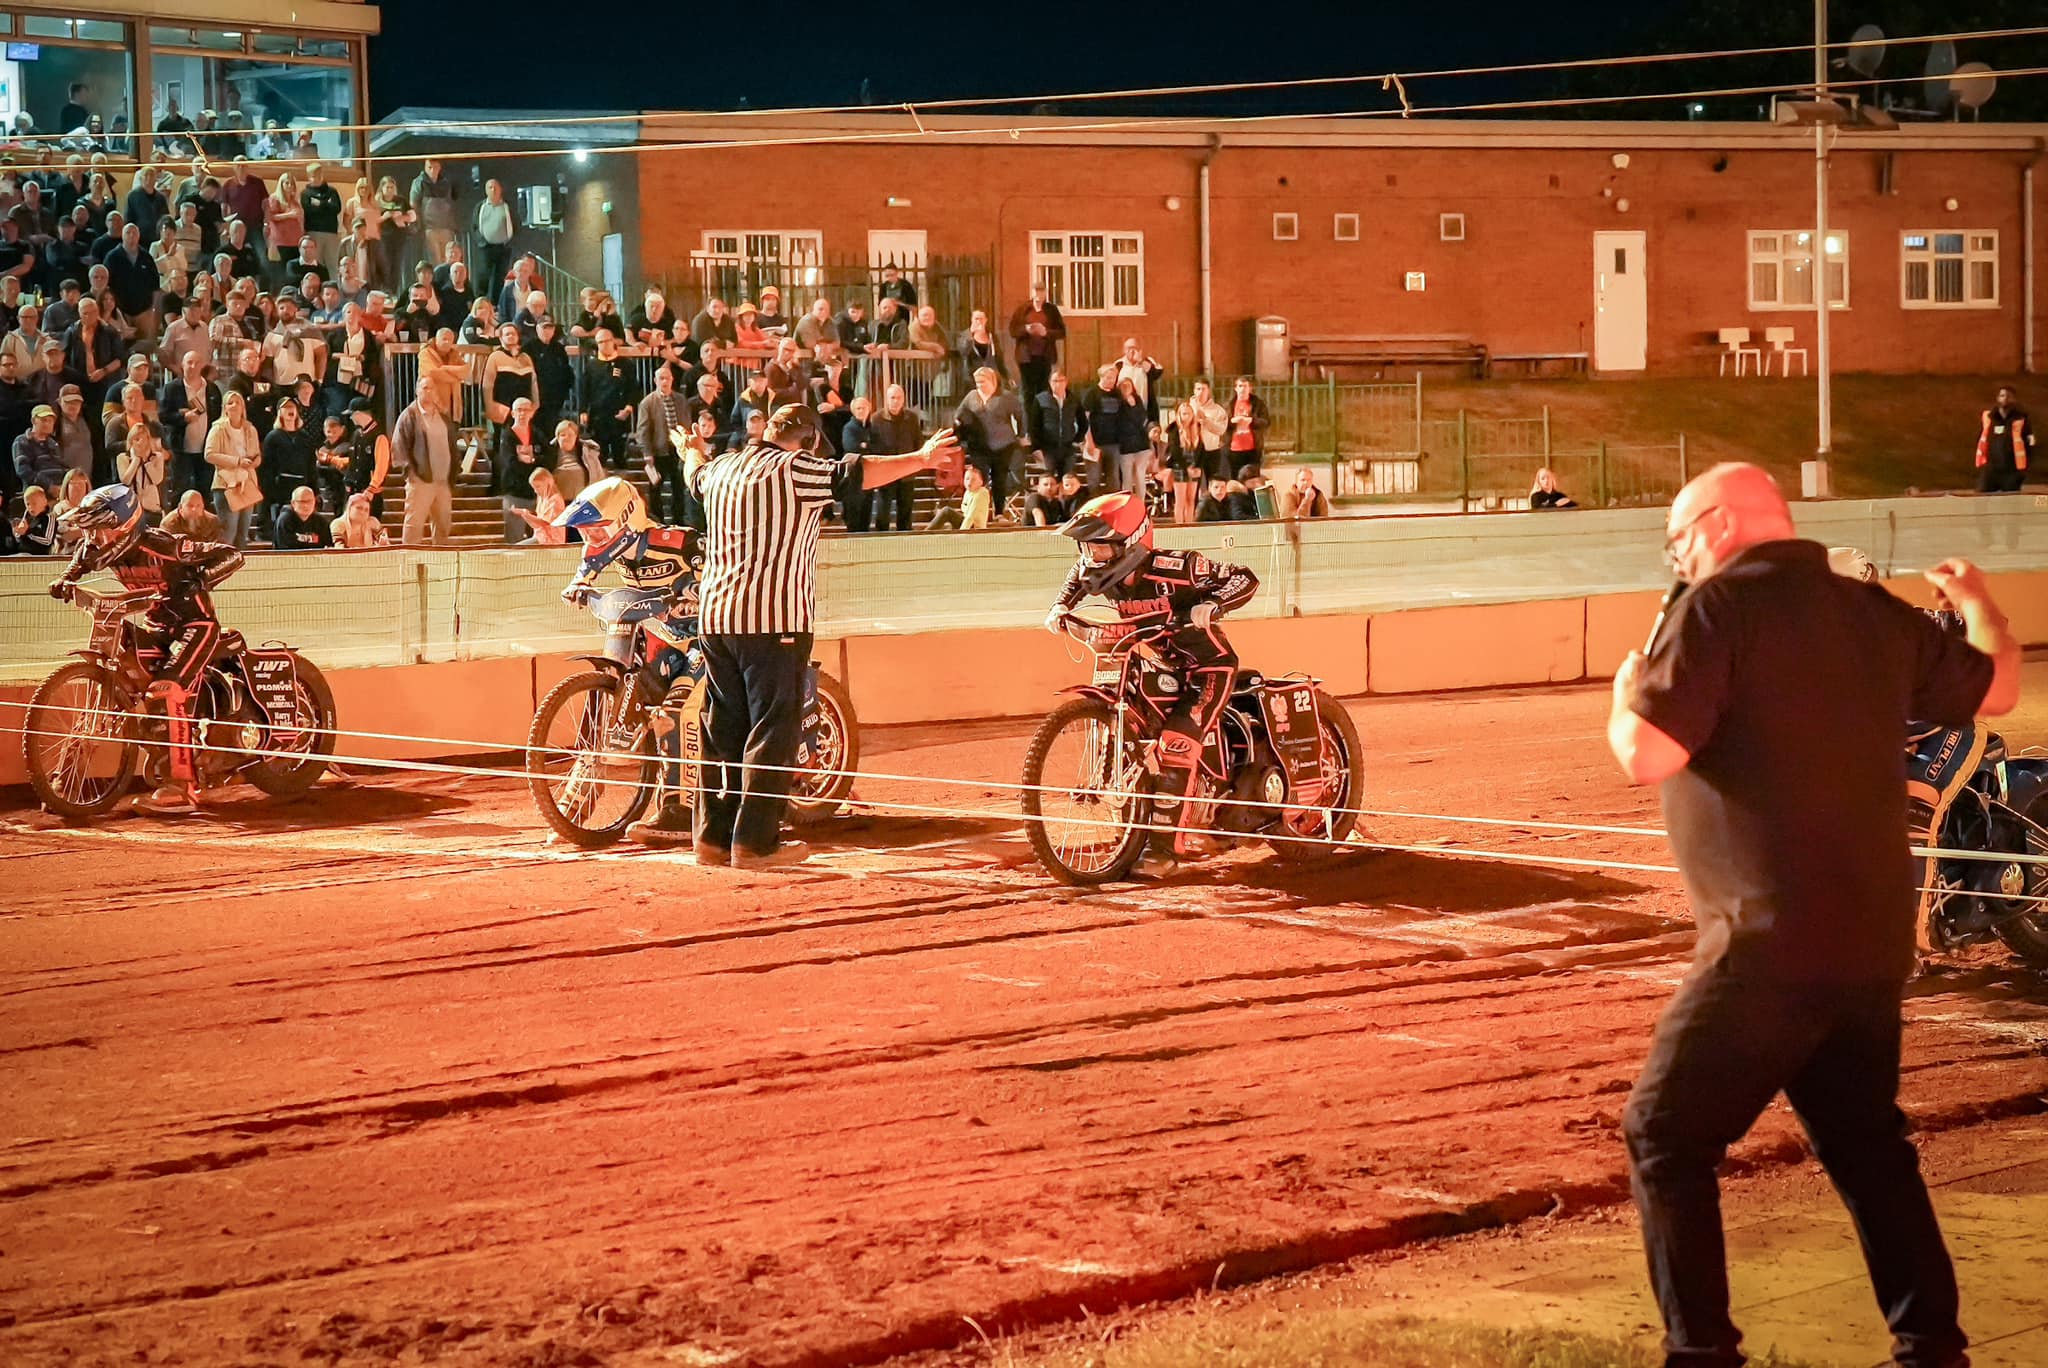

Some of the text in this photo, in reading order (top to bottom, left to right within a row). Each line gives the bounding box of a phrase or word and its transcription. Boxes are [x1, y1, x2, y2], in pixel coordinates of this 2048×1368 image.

[1224, 536, 1234, 547] 10
[1162, 583, 1168, 595] 3
[253, 661, 290, 671] JWP
[1293, 690, 1312, 712] 22
